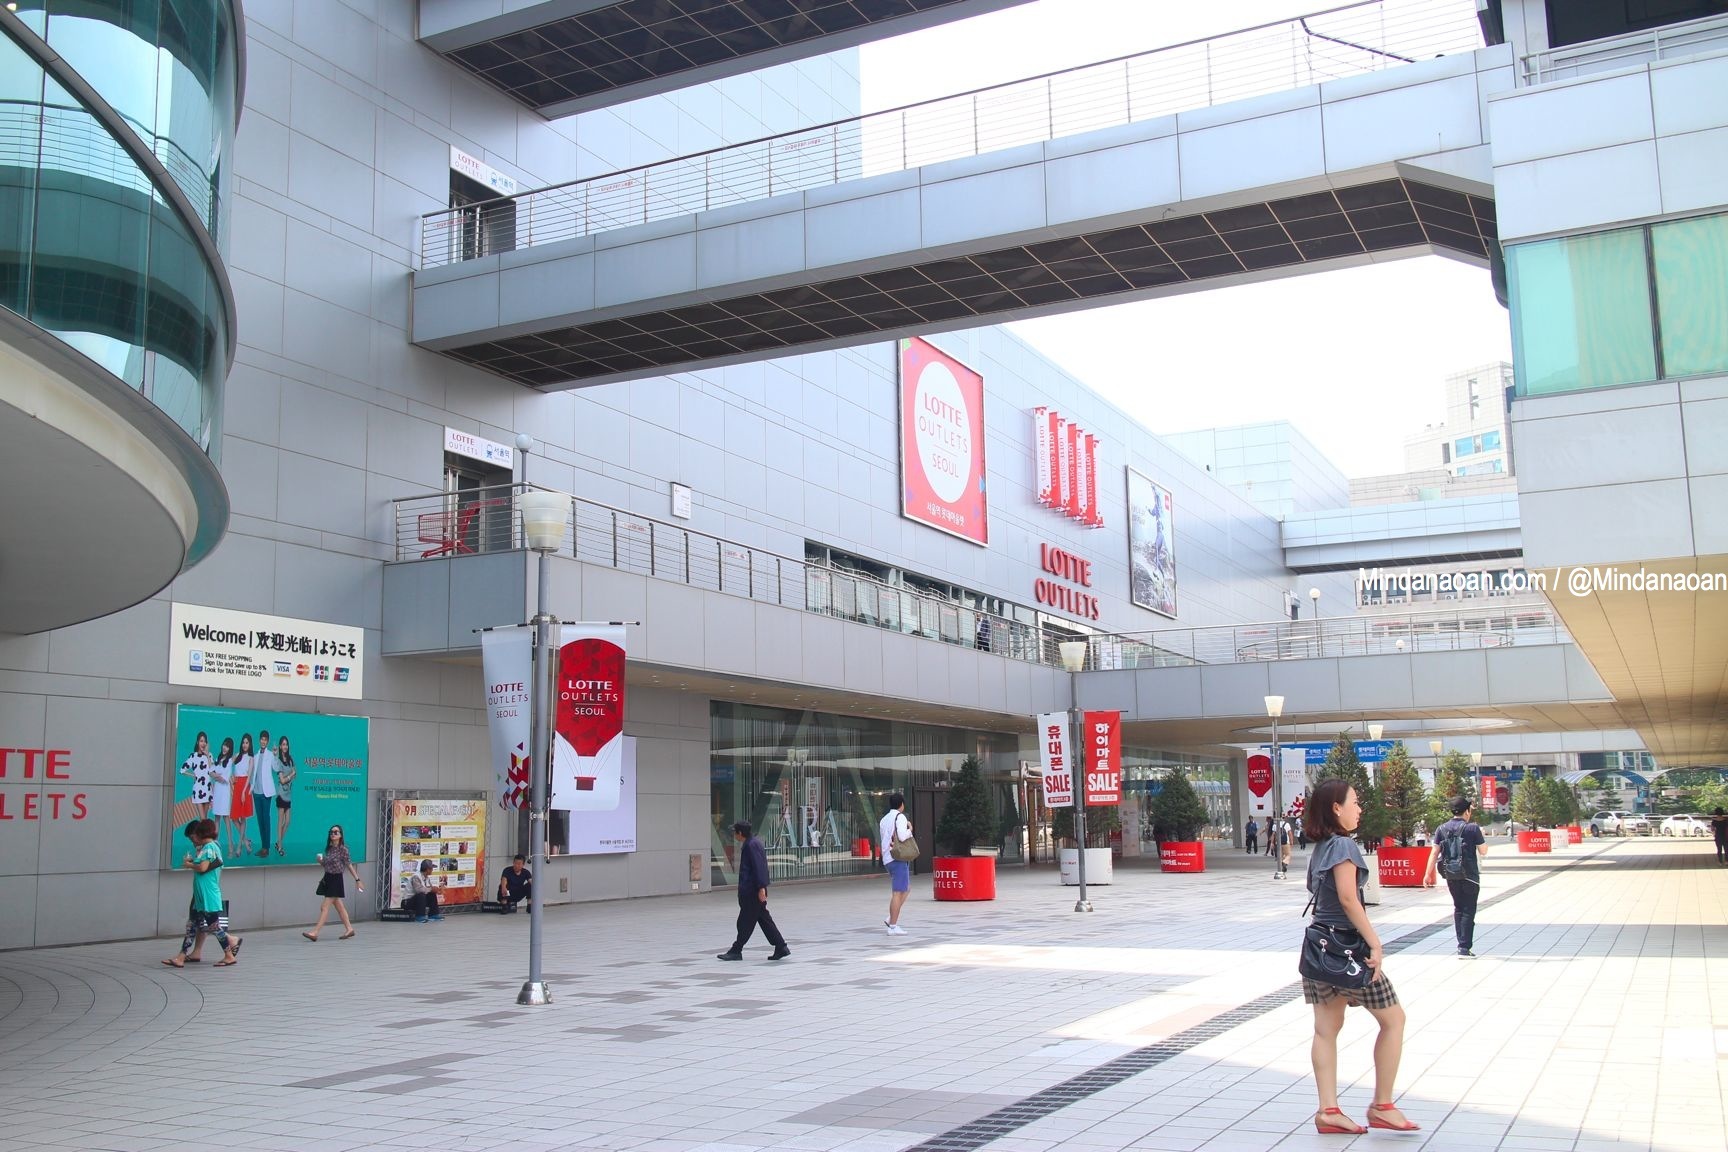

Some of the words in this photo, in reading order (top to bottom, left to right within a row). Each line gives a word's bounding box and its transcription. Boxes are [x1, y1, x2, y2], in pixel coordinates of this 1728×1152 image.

[457, 153, 480, 169] LOTTE
[924, 392, 962, 428] LOTTE
[452, 433, 475, 446] LOTTE
[919, 415, 968, 454] OUTLETS
[448, 441, 478, 456] OUTLETS
[932, 453, 959, 478] SEOUL
[1040, 542, 1092, 588] LOTTE
[1035, 577, 1101, 621] OUTLETS
[183, 623, 246, 645] Welcome
[256, 631, 312, 655] 欢迎光临
[320, 640, 356, 658] ようこそ
[228, 654, 252, 663] SHOPPING
[276, 665, 290, 673] VISA
[490, 682, 524, 694] LOTTE
[568, 679, 613, 690] LOTTE
[488, 694, 529, 706] OUTLETS
[561, 691, 618, 702] OUTLETS
[496, 709, 518, 719] SEOUL
[574, 707, 605, 717] SEOUL
[1047, 725, 1063, 771] 휴대폰
[1095, 723, 1110, 770] 하이마트
[0, 748, 71, 779] TTE
[1045, 774, 1071, 794] SALE
[1087, 772, 1118, 792] SALE
[0, 793, 87, 820] LETS
[764, 805, 842, 850] ARA
[1380, 859, 1410, 867] LOTTE
